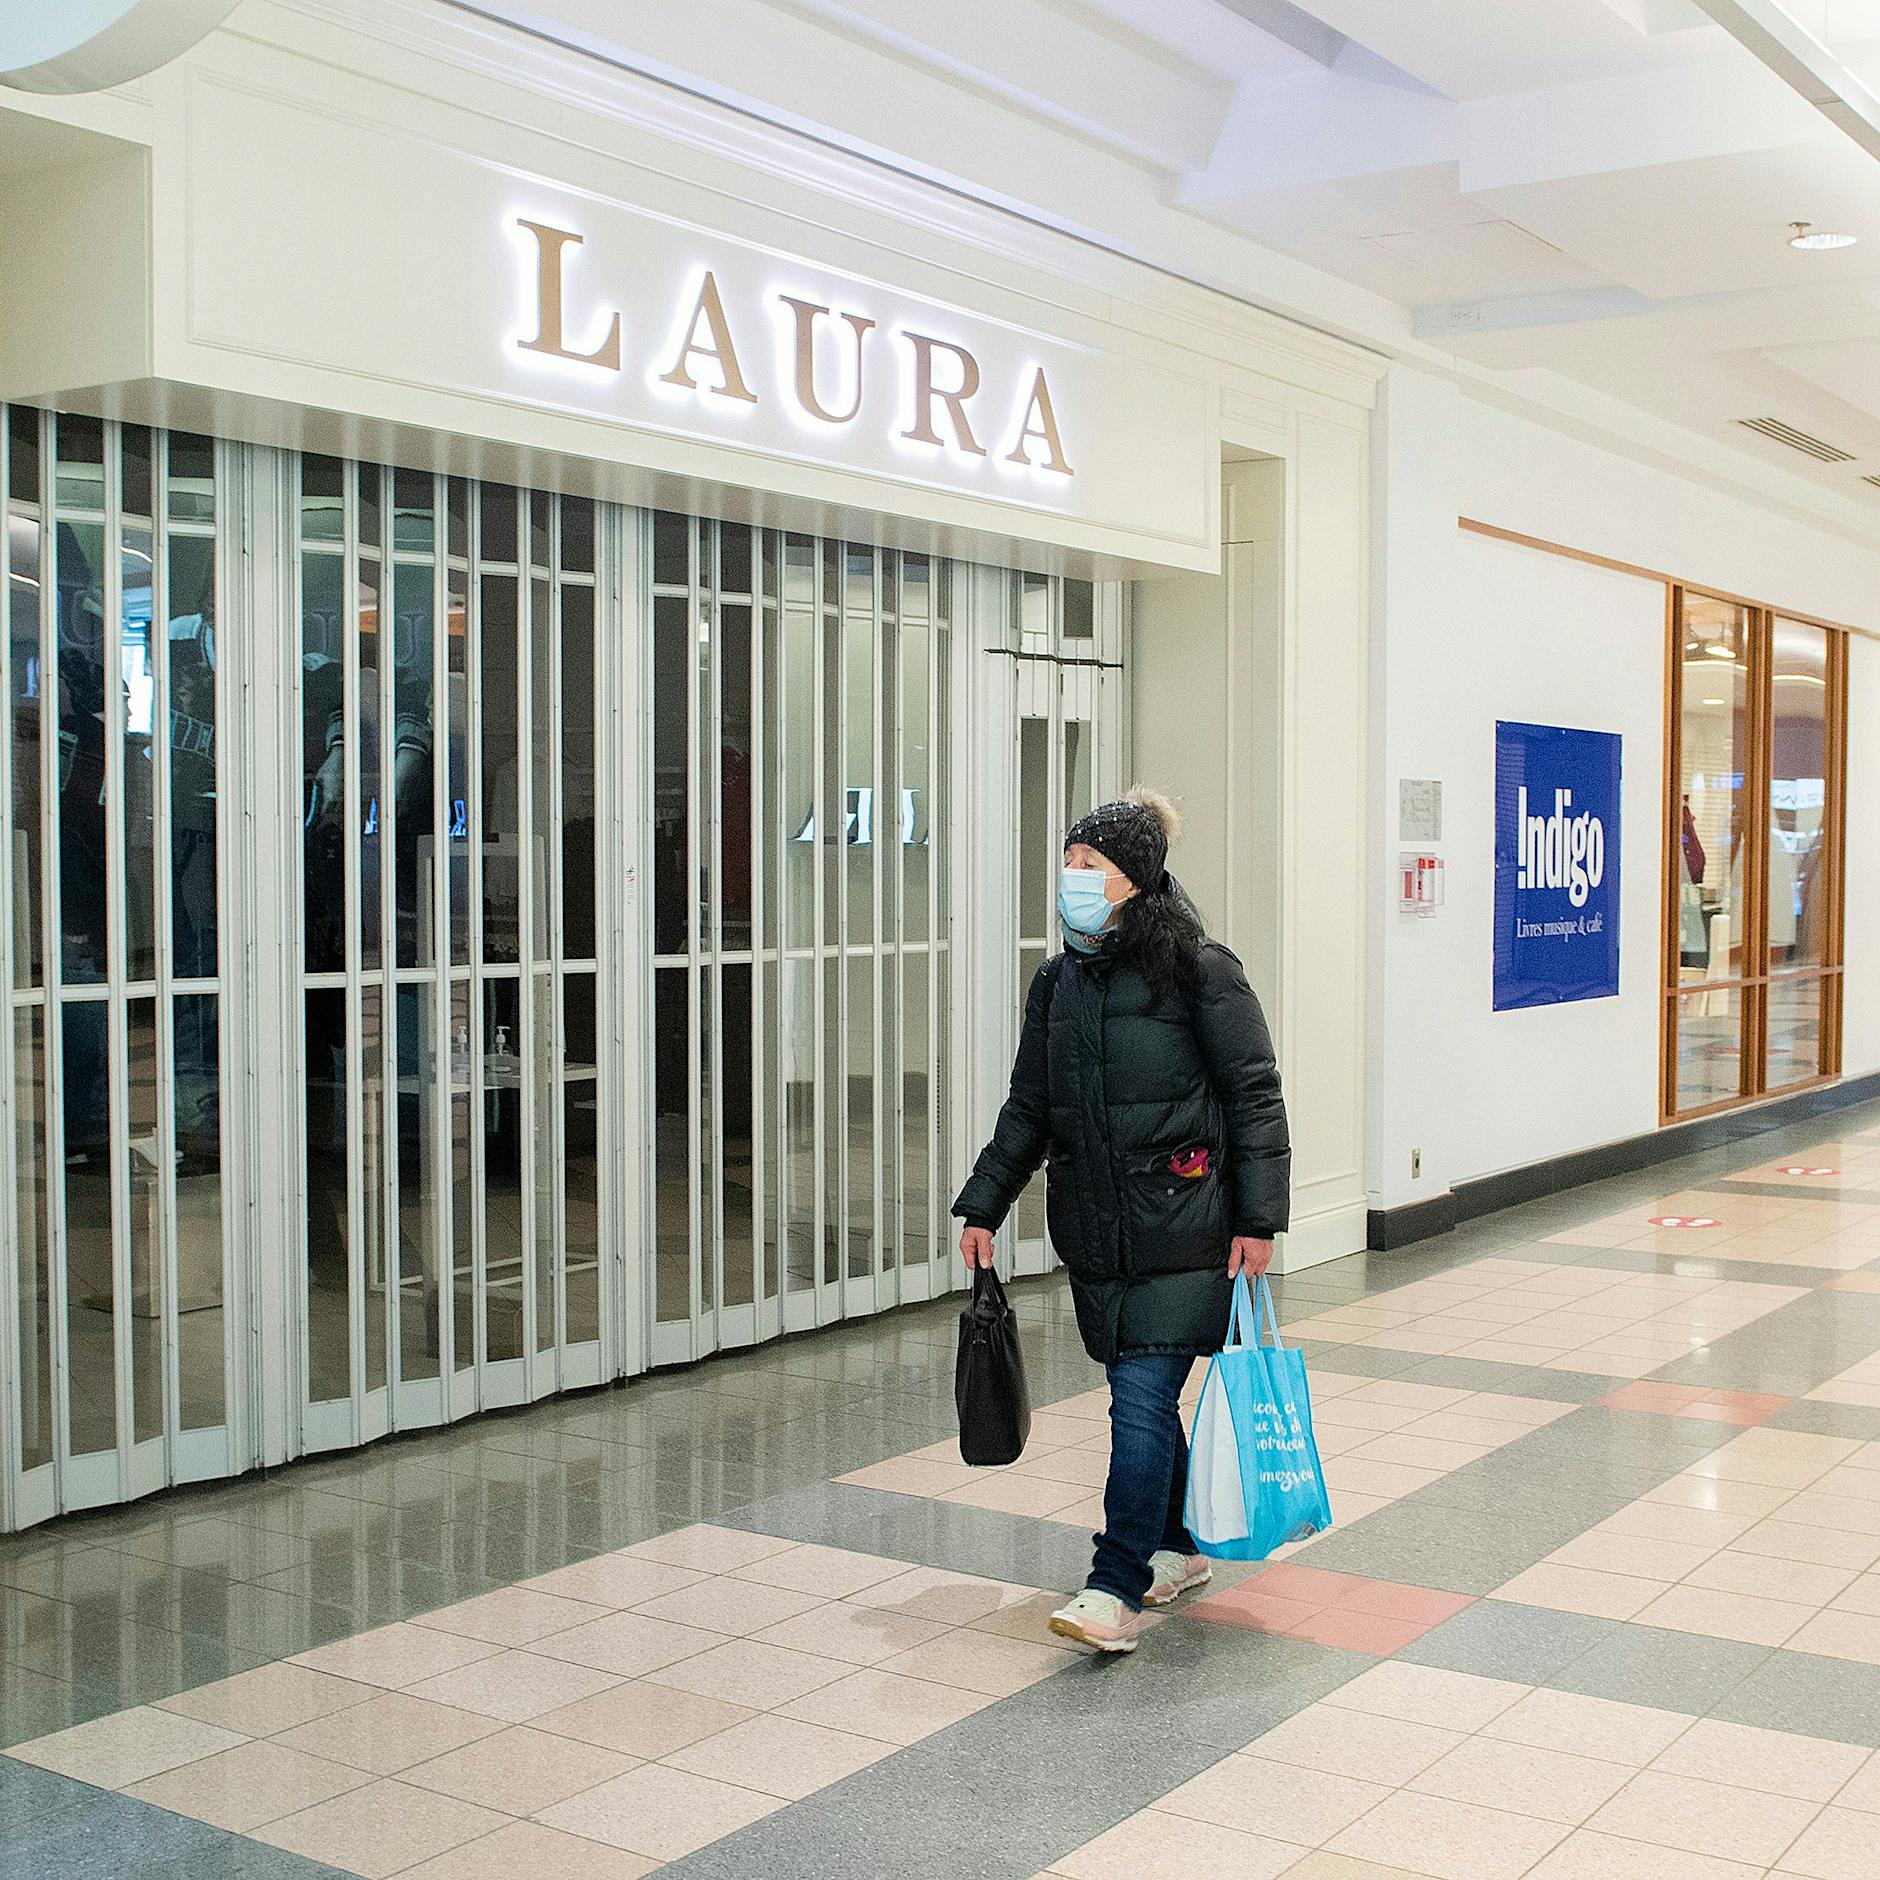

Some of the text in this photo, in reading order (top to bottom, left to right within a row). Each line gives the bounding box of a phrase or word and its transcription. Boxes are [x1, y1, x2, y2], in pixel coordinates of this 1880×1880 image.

[516, 217, 1074, 477] LAURA
[1516, 917, 1542, 938] Livres
[1543, 916, 1577, 943] musique
[1577, 915, 1587, 936] &
